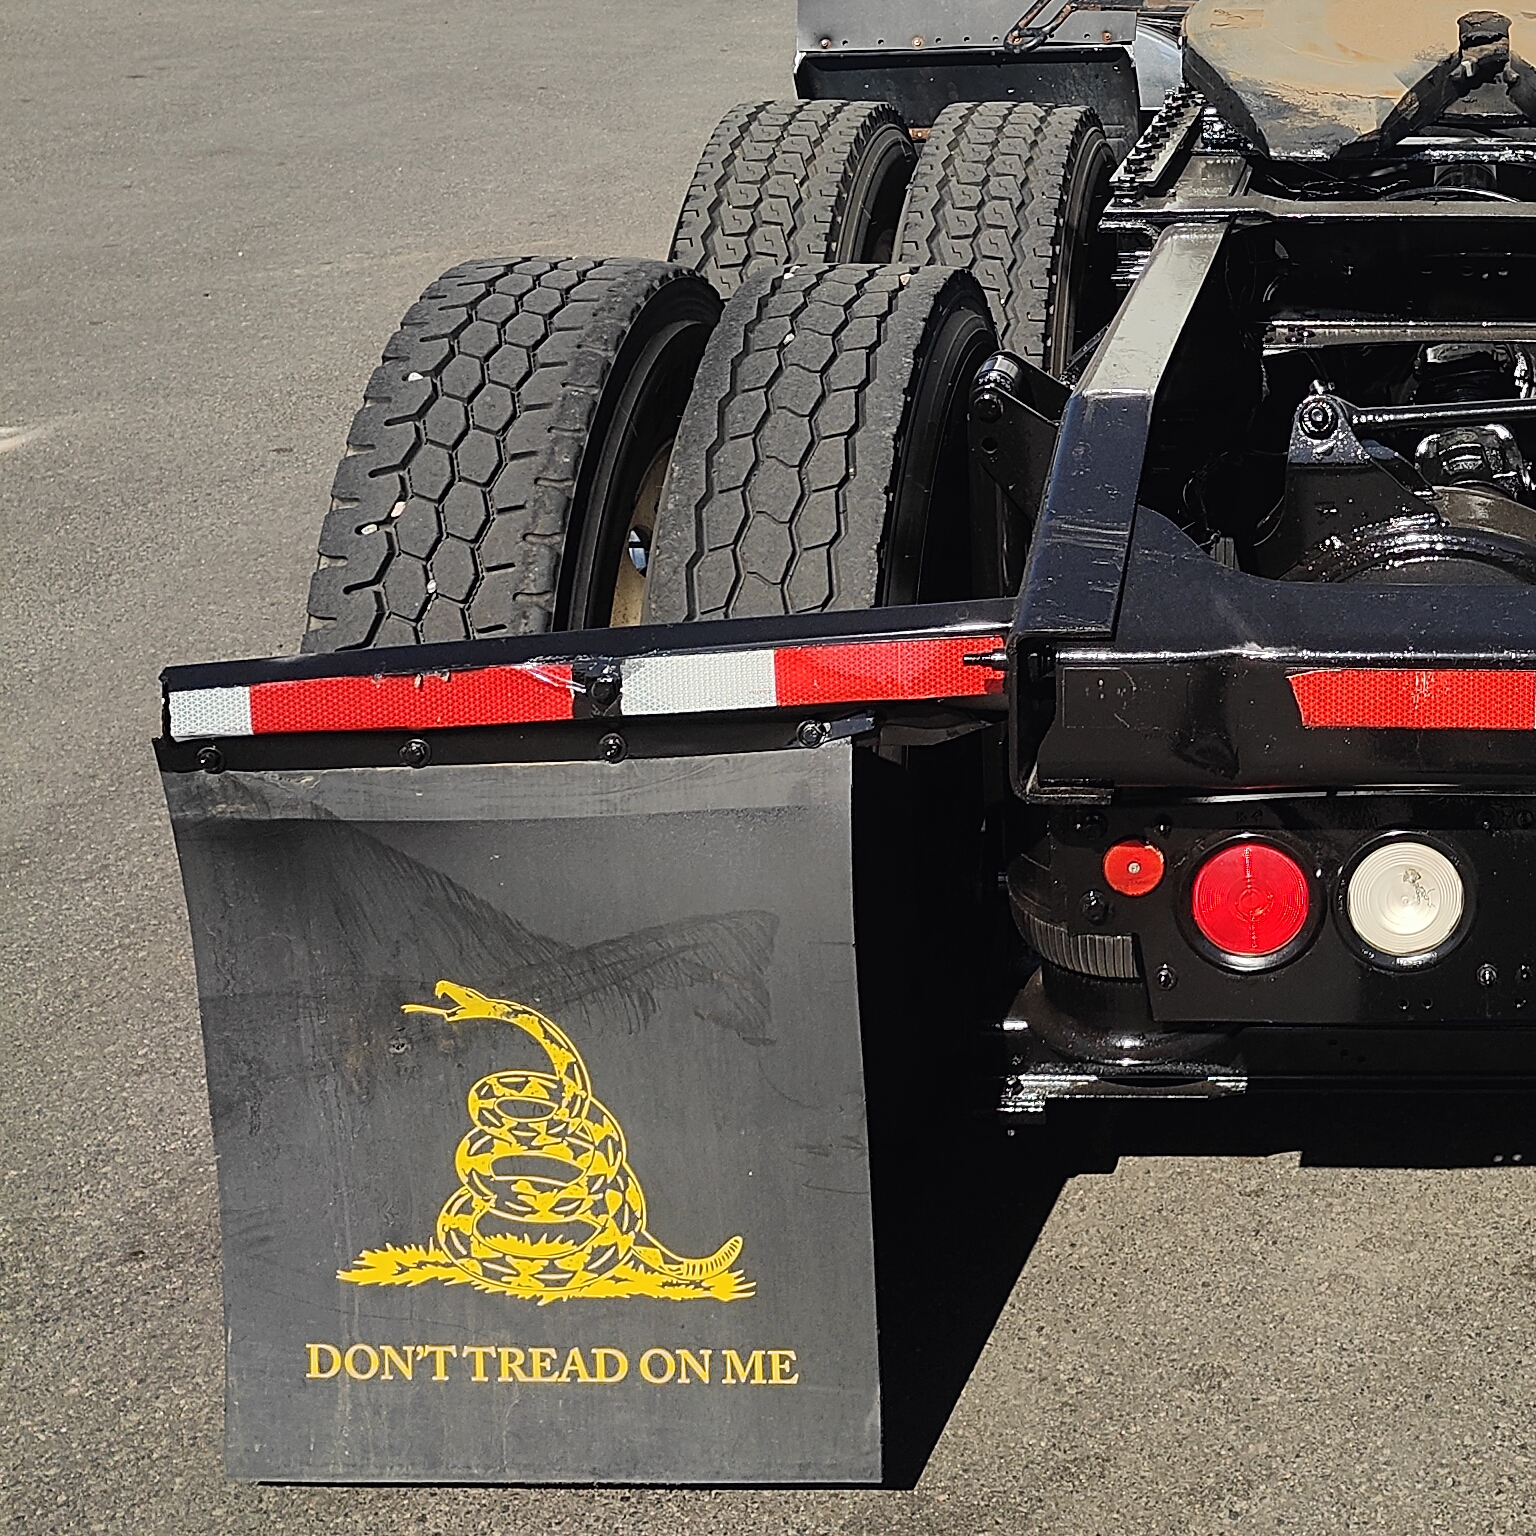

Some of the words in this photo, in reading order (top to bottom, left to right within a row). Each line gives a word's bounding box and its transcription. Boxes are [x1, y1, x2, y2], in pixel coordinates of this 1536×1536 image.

[305, 1342, 458, 1382] DON'T
[461, 1344, 629, 1385] TREAD
[638, 1347, 713, 1385] ON
[721, 1348, 800, 1385] ME
